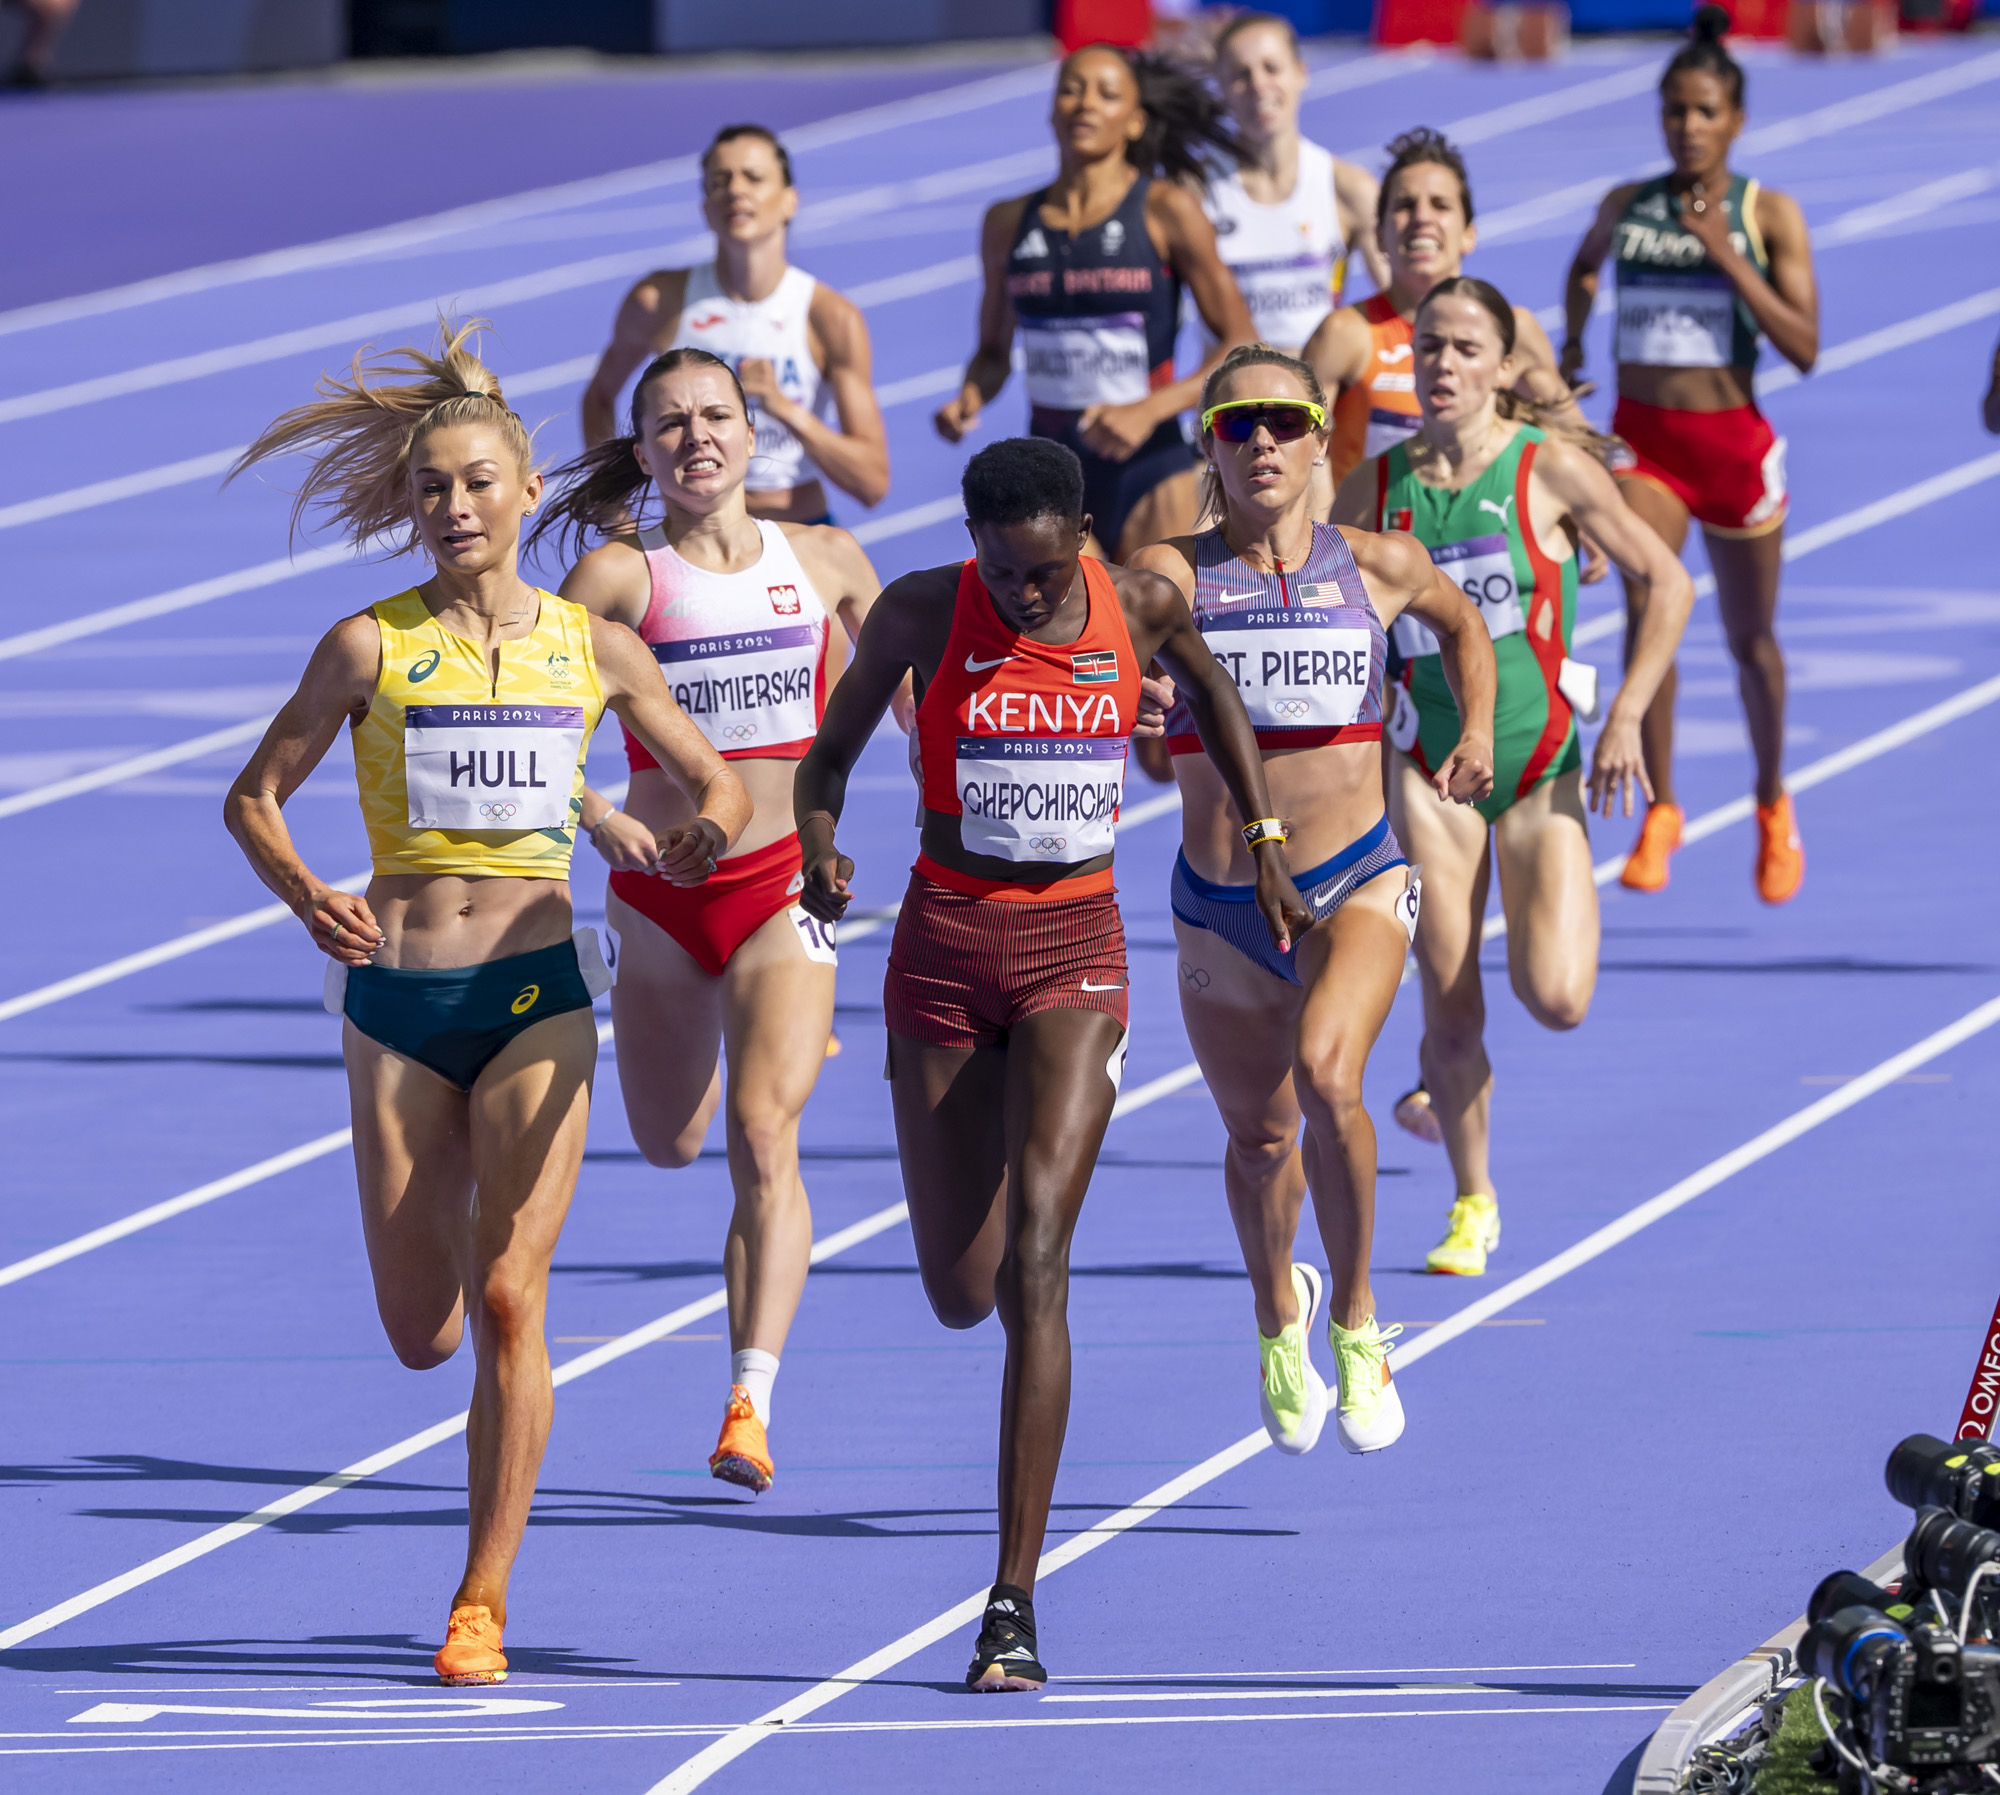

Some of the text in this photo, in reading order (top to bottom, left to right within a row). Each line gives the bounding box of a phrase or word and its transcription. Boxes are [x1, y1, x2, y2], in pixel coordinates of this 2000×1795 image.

[1247, 612, 1329, 624] PARIS 2024
[690, 636, 772, 655] PARIS 2024
[1262, 650, 1367, 687] PIERRE
[668, 667, 811, 715] AZIMIERSKA
[453, 710, 541, 722] PARIS 2024
[967, 692, 1120, 733] KENYA
[1004, 743, 1093, 755] PARIS 2024
[450, 750, 547, 788] HULL
[797, 915, 836, 952] 10
